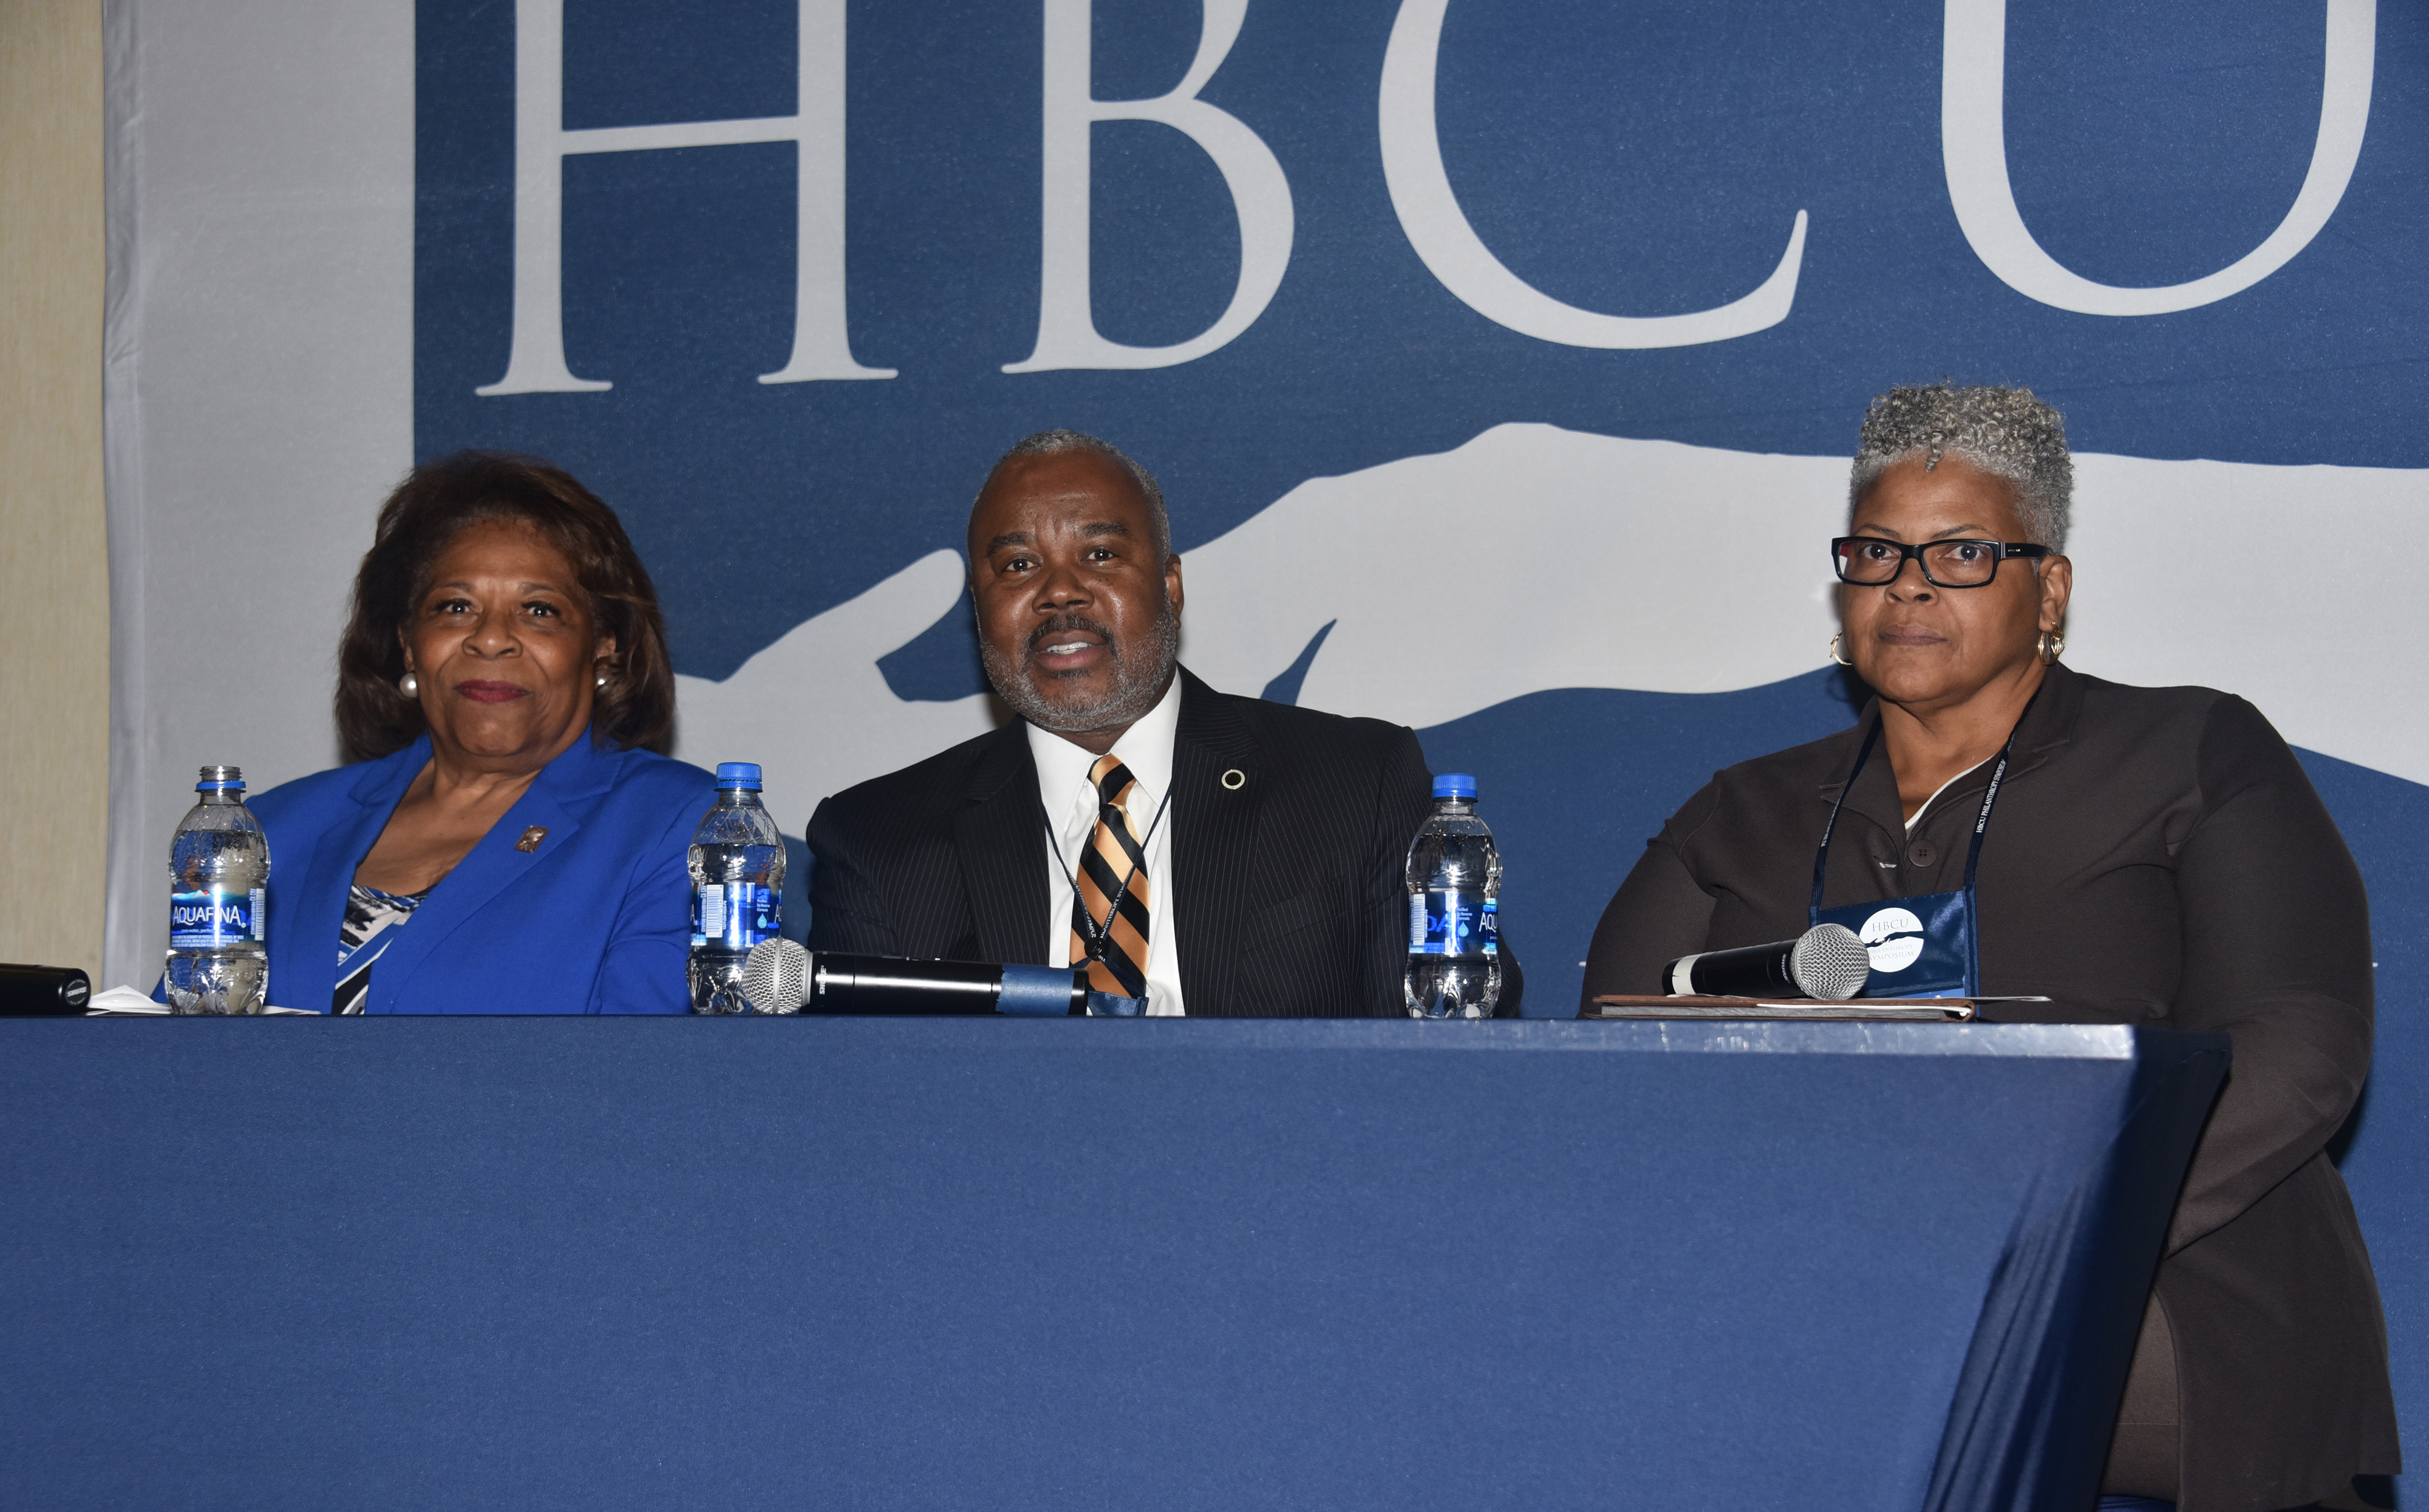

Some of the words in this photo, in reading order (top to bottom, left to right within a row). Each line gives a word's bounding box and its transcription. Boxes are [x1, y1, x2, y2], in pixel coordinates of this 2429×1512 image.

[475, 0, 2378, 396] HBCU
[1976, 817, 1986, 833] HBCU
[1981, 780, 1998, 816] PHILANTHROPY
[1993, 758, 2006, 782] SYMPOSIUM
[1872, 918, 1909, 932] HBCU
[1869, 944, 1913, 955] PHILANTHROPY
[1869, 950, 1914, 961] SYMPOSIUM
[67, 986, 87, 997] SHURE
